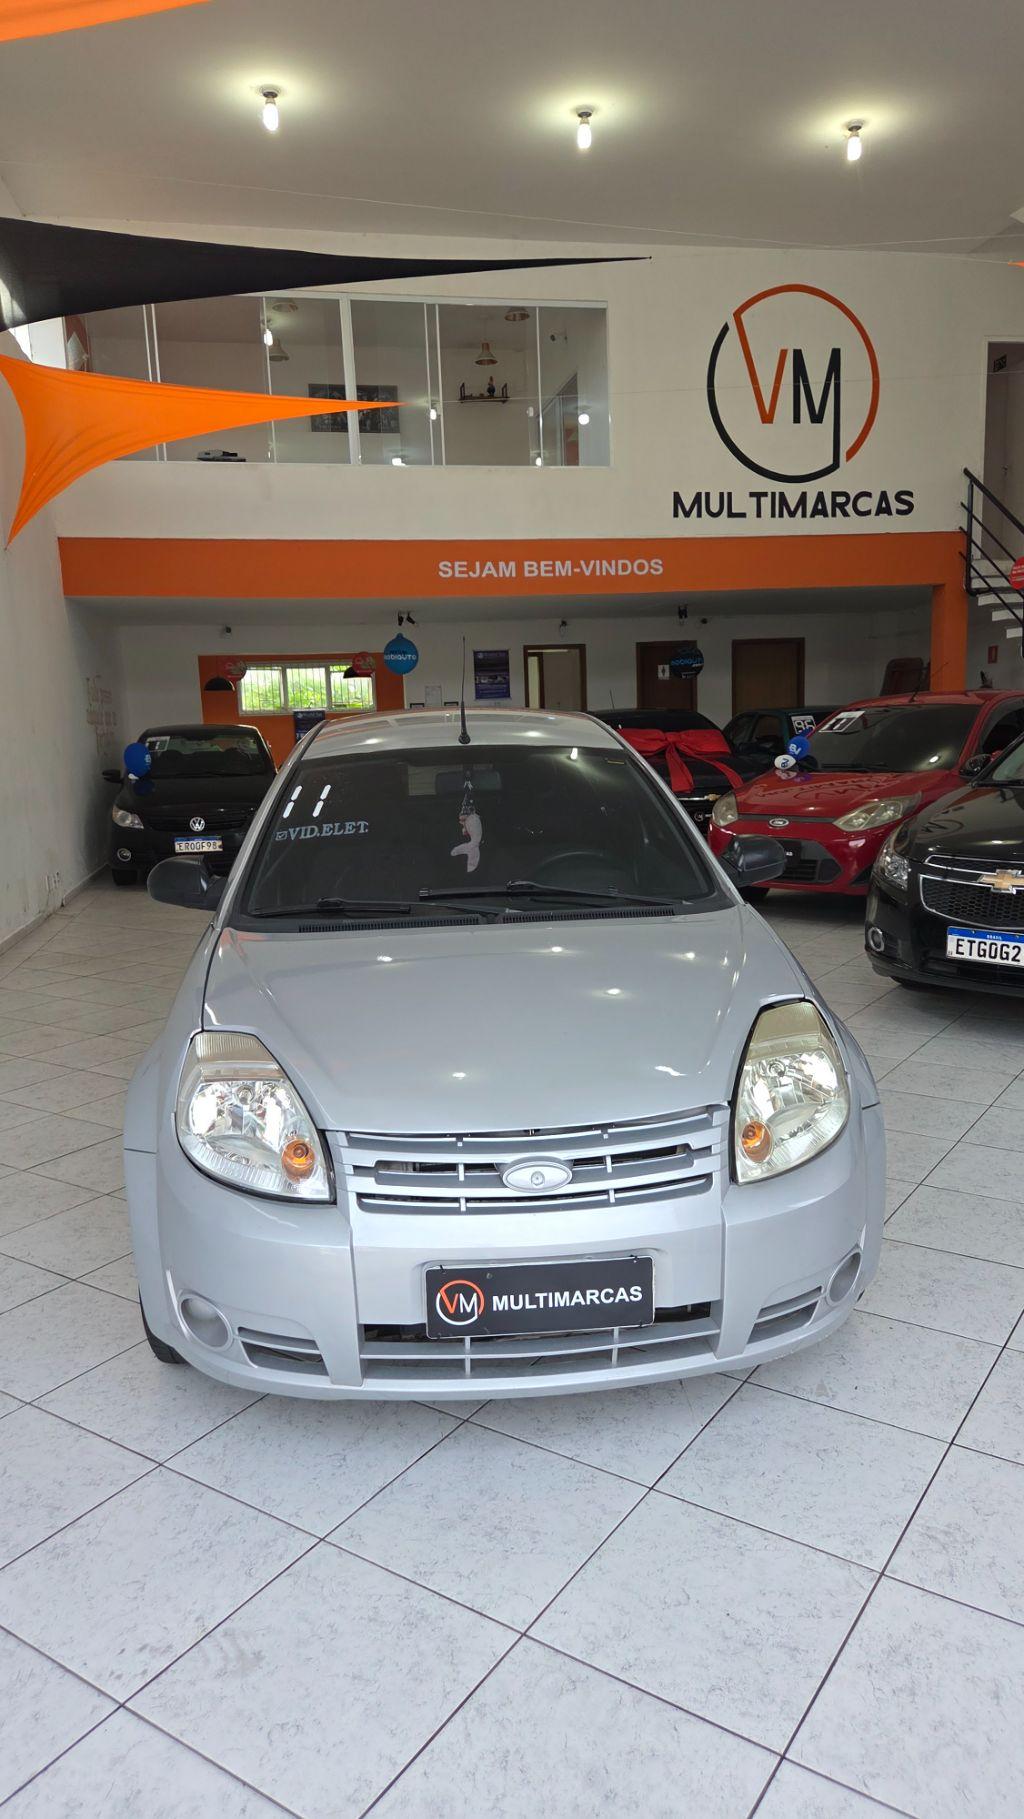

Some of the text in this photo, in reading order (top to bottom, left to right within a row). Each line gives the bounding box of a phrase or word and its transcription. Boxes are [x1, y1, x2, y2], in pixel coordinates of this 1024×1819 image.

[672, 490, 915, 519] MULTIMARCAS
[438, 559, 664, 578] SEJAM BEM-VINDOS
[282, 784, 331, 818] 11
[438, 1284, 643, 1320] VM MULTIMARCAS
